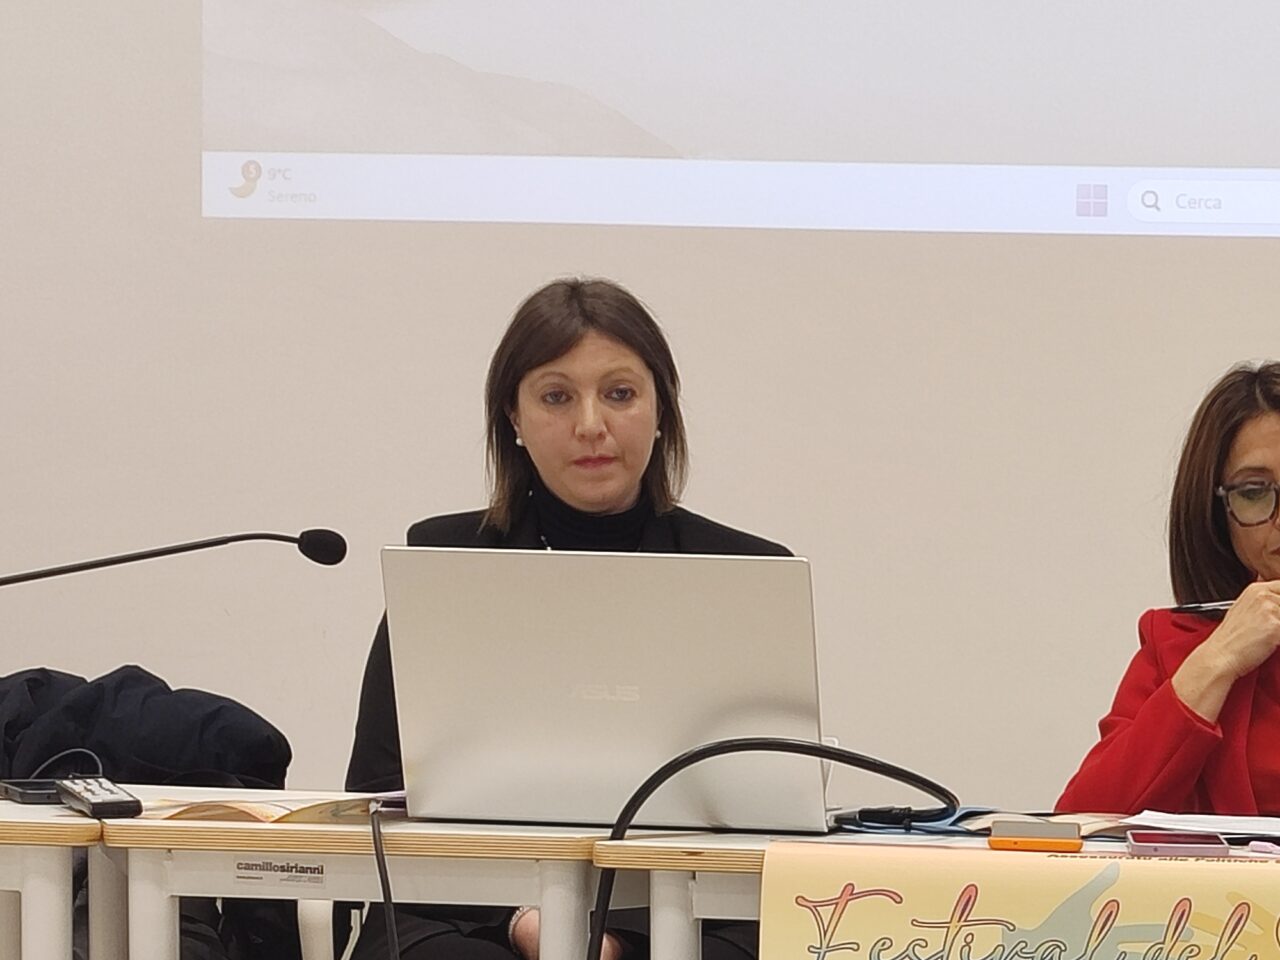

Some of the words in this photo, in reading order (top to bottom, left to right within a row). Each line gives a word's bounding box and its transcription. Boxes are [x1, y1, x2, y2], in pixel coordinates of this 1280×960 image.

[268, 189, 317, 202] Sereno
[1176, 193, 1222, 210] Cerca
[236, 862, 324, 874] camillosirianni
